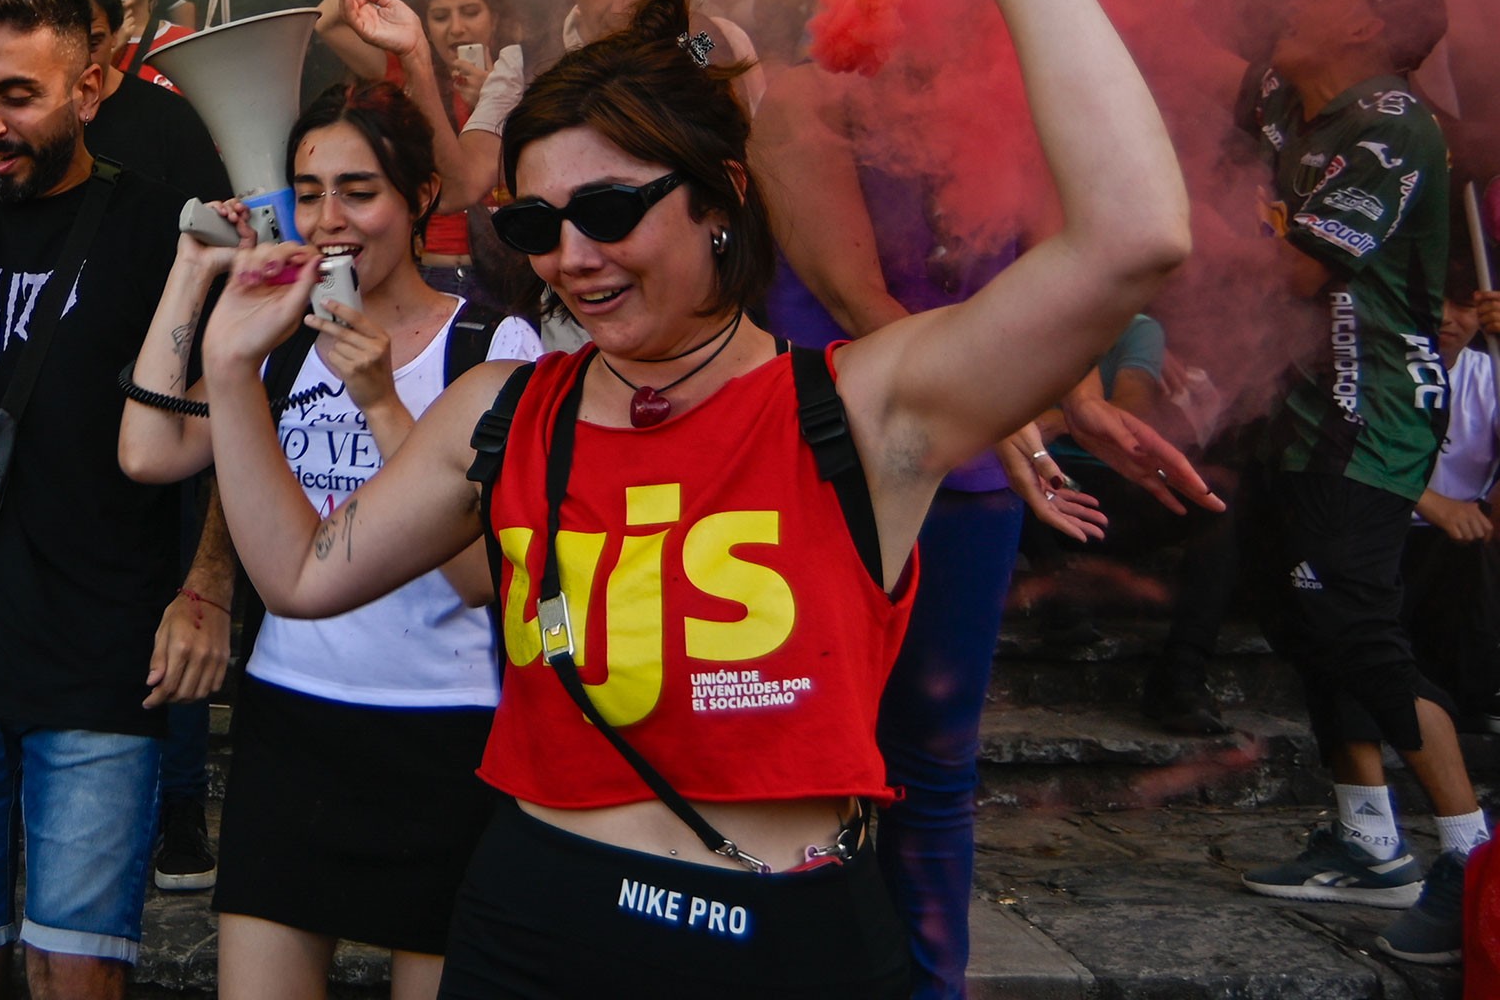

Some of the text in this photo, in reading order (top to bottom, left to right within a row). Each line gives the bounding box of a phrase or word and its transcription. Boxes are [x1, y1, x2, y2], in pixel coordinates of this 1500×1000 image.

[326, 430, 383, 469] VE
[690, 669, 759, 686] UNIÓN DE
[691, 677, 811, 699] JUVENTUDES POR
[692, 691, 795, 711] EL SOCIALISMO
[618, 878, 747, 934] NIKE PRO
